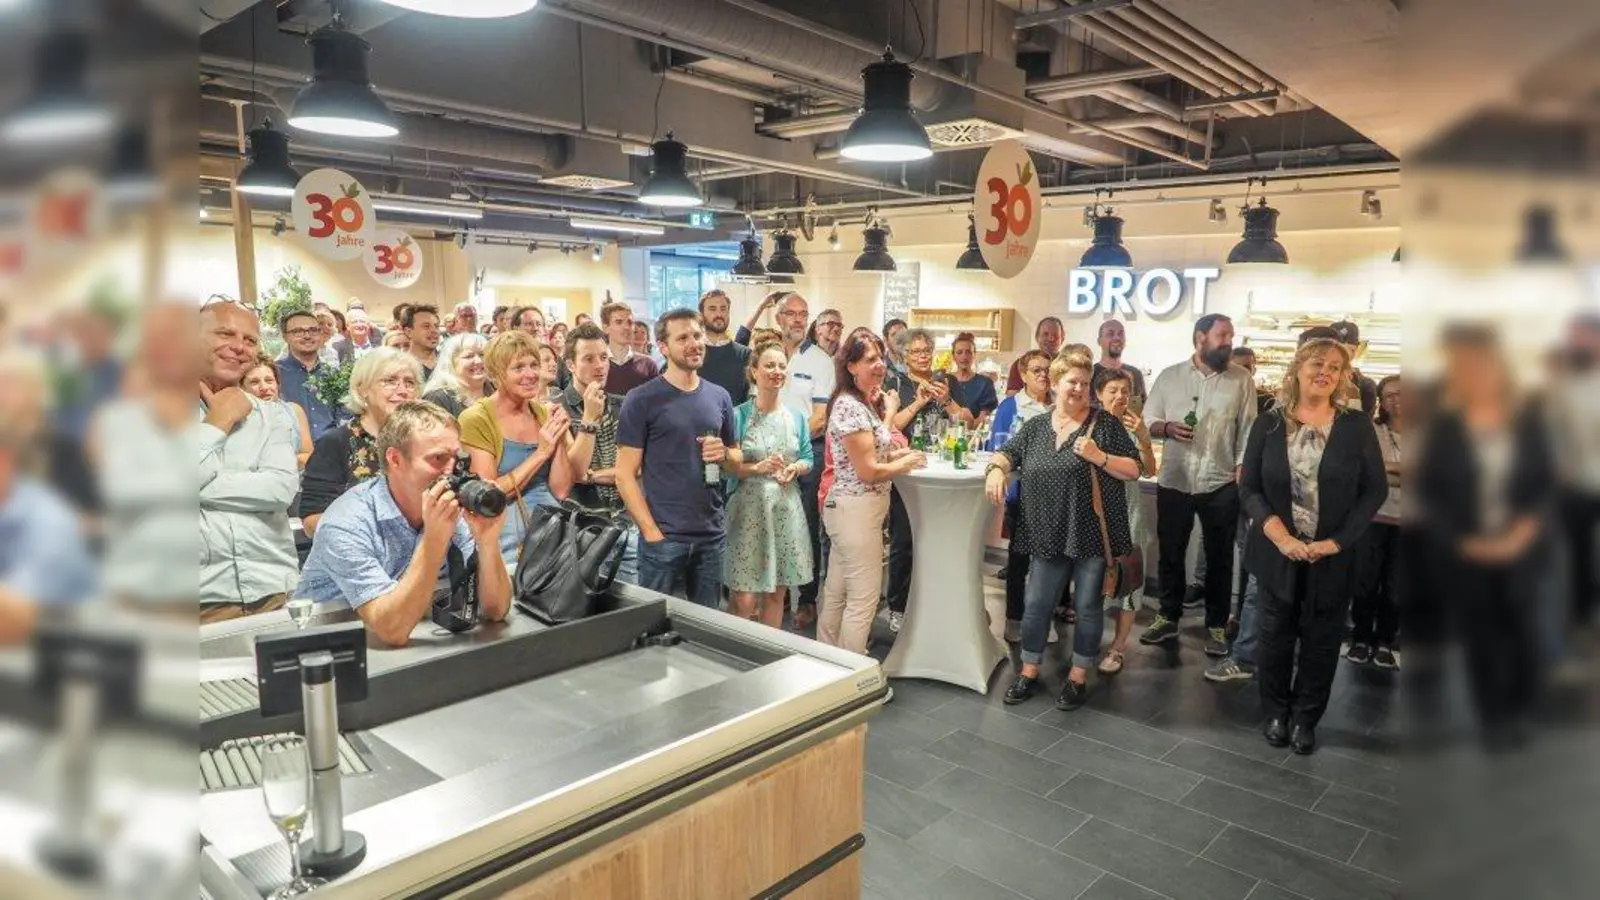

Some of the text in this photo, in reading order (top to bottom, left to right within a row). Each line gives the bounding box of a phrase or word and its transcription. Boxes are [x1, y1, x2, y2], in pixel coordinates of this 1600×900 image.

[305, 192, 364, 238] 30
[984, 177, 1031, 245] 30
[373, 243, 414, 274] 30
[1067, 267, 1220, 317] BROT
